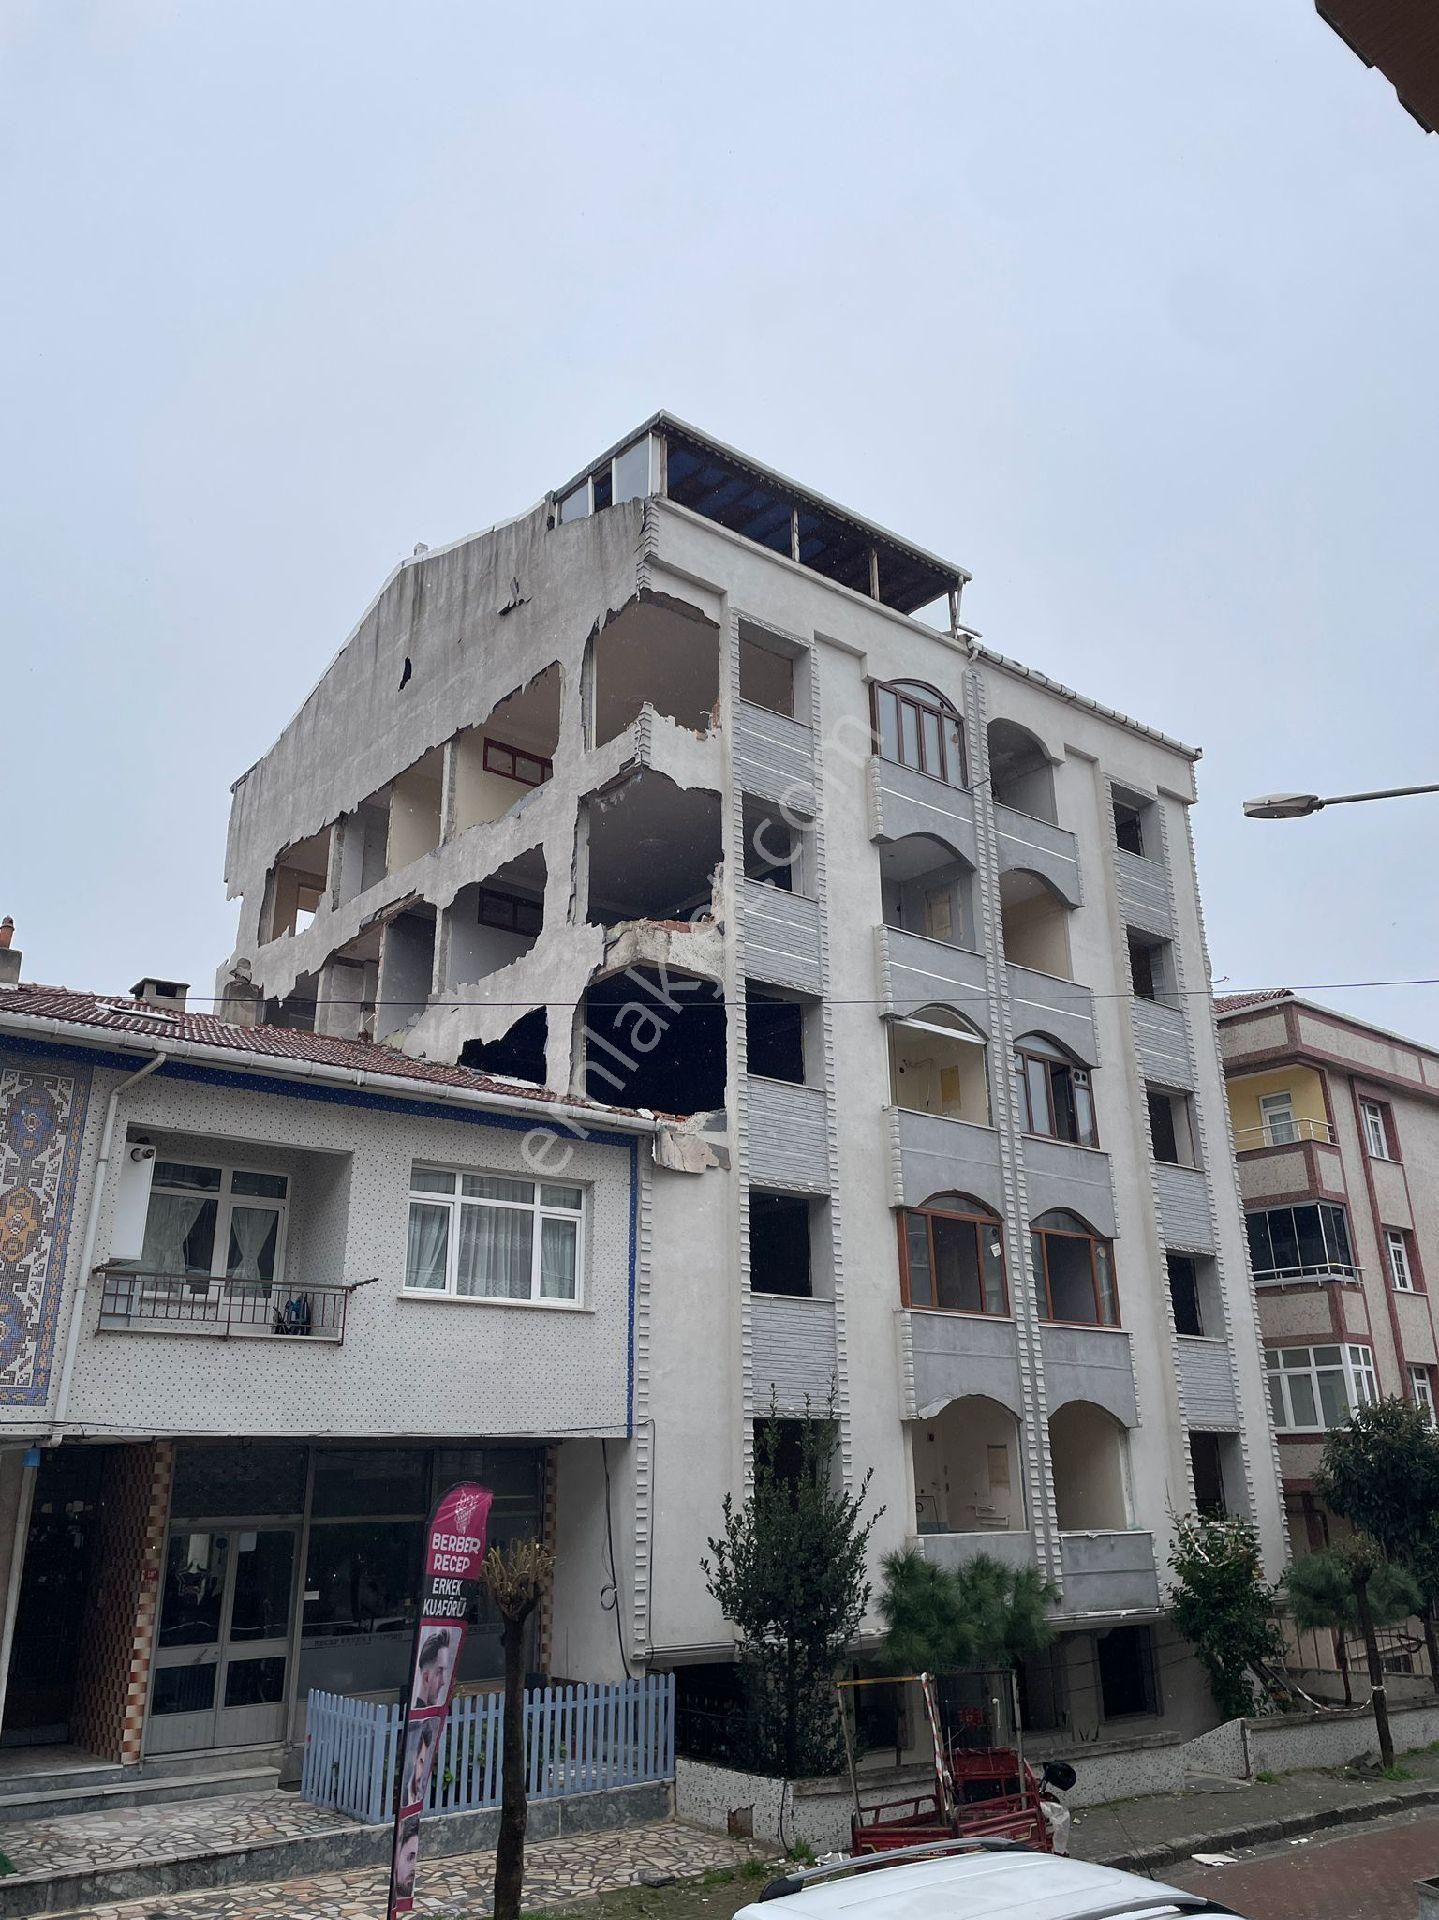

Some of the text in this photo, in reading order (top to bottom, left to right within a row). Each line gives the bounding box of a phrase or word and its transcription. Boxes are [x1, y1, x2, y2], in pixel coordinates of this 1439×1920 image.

[432, 1533, 481, 1555] BERBER
[433, 1554, 471, 1574] RECEP
[432, 1577, 463, 1597] ERKEK
[422, 1596, 468, 1617] KUAFÖRÜ
